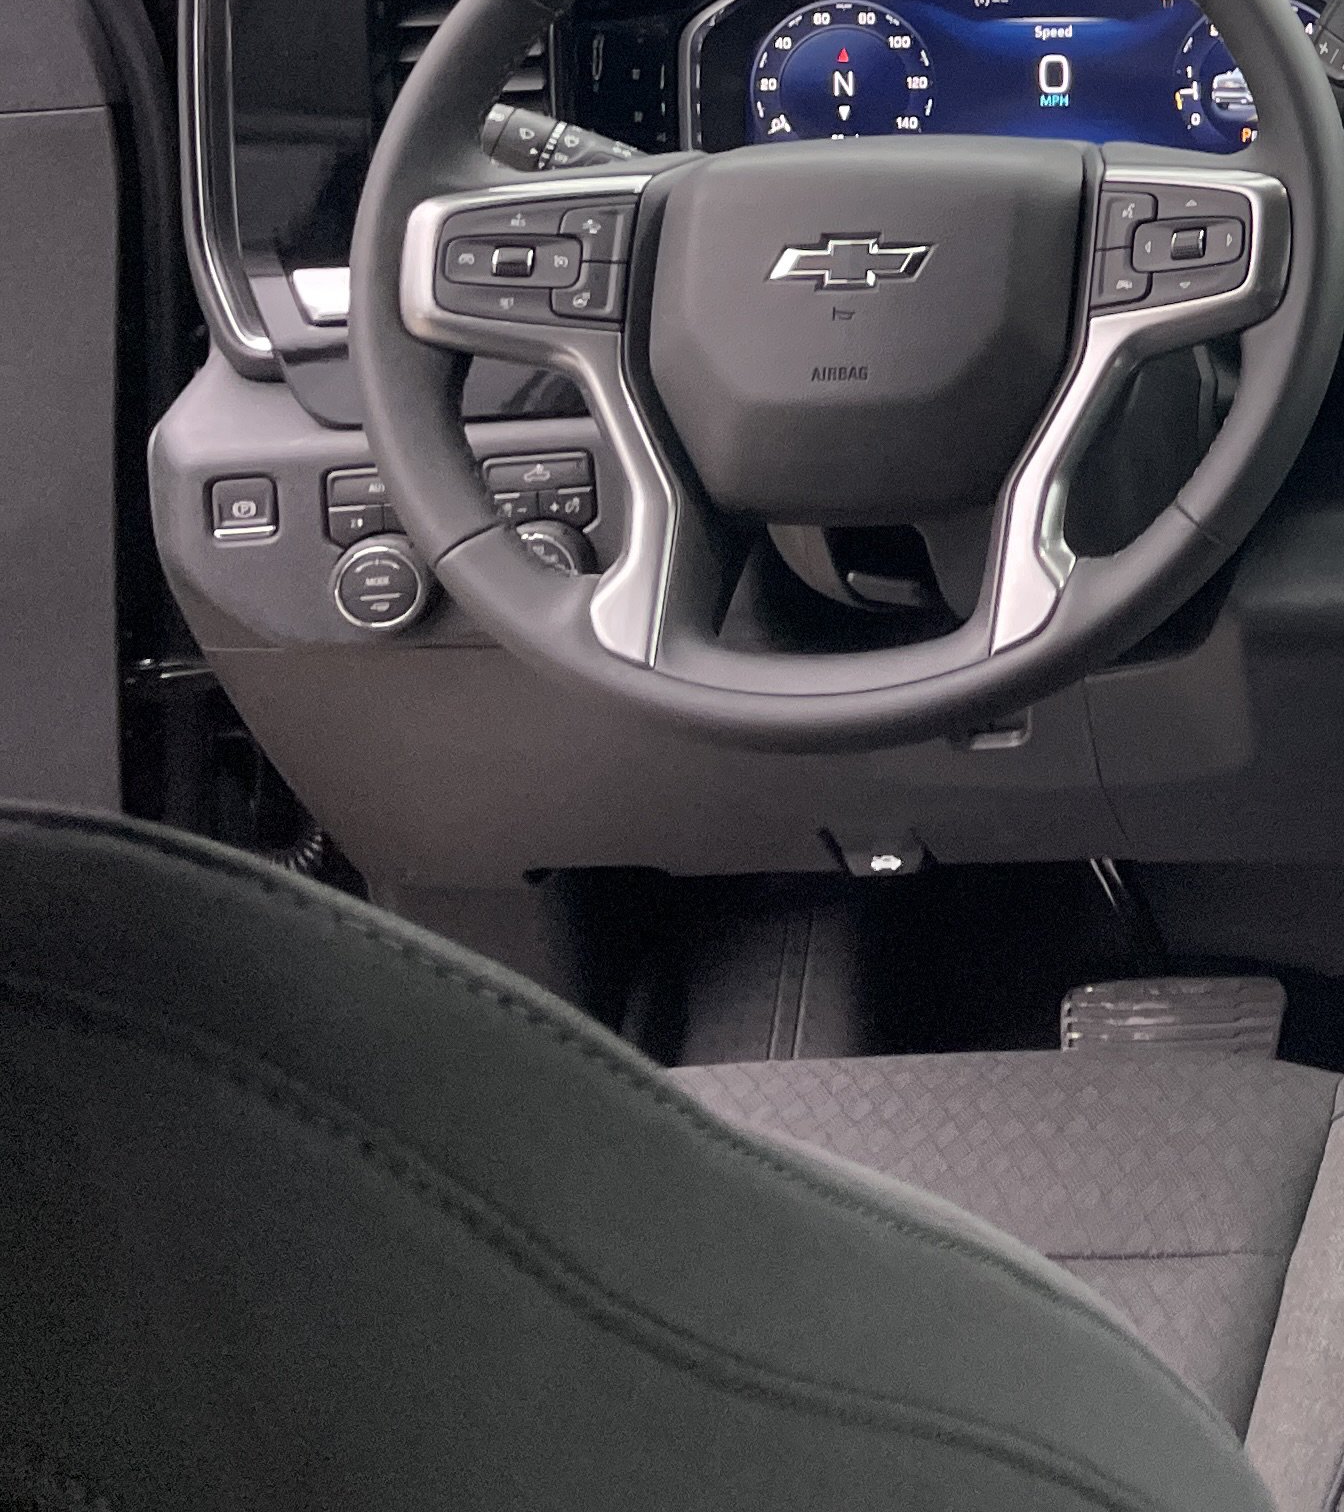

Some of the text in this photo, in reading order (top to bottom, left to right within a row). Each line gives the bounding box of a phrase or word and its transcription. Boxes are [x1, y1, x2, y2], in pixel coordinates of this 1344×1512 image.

[1034, 24, 1073, 40] Speed
[774, 37, 792, 49] 40
[888, 36, 911, 48] 100
[1039, 54, 1069, 94] 0
[760, 78, 777, 91] 20
[833, 70, 854, 97] N
[906, 76, 928, 89] 120
[1040, 93, 1069, 107] MPH
[896, 117, 918, 130] 140
[1191, 112, 1200, 126] 0
[811, 366, 868, 382] AIRBAG
